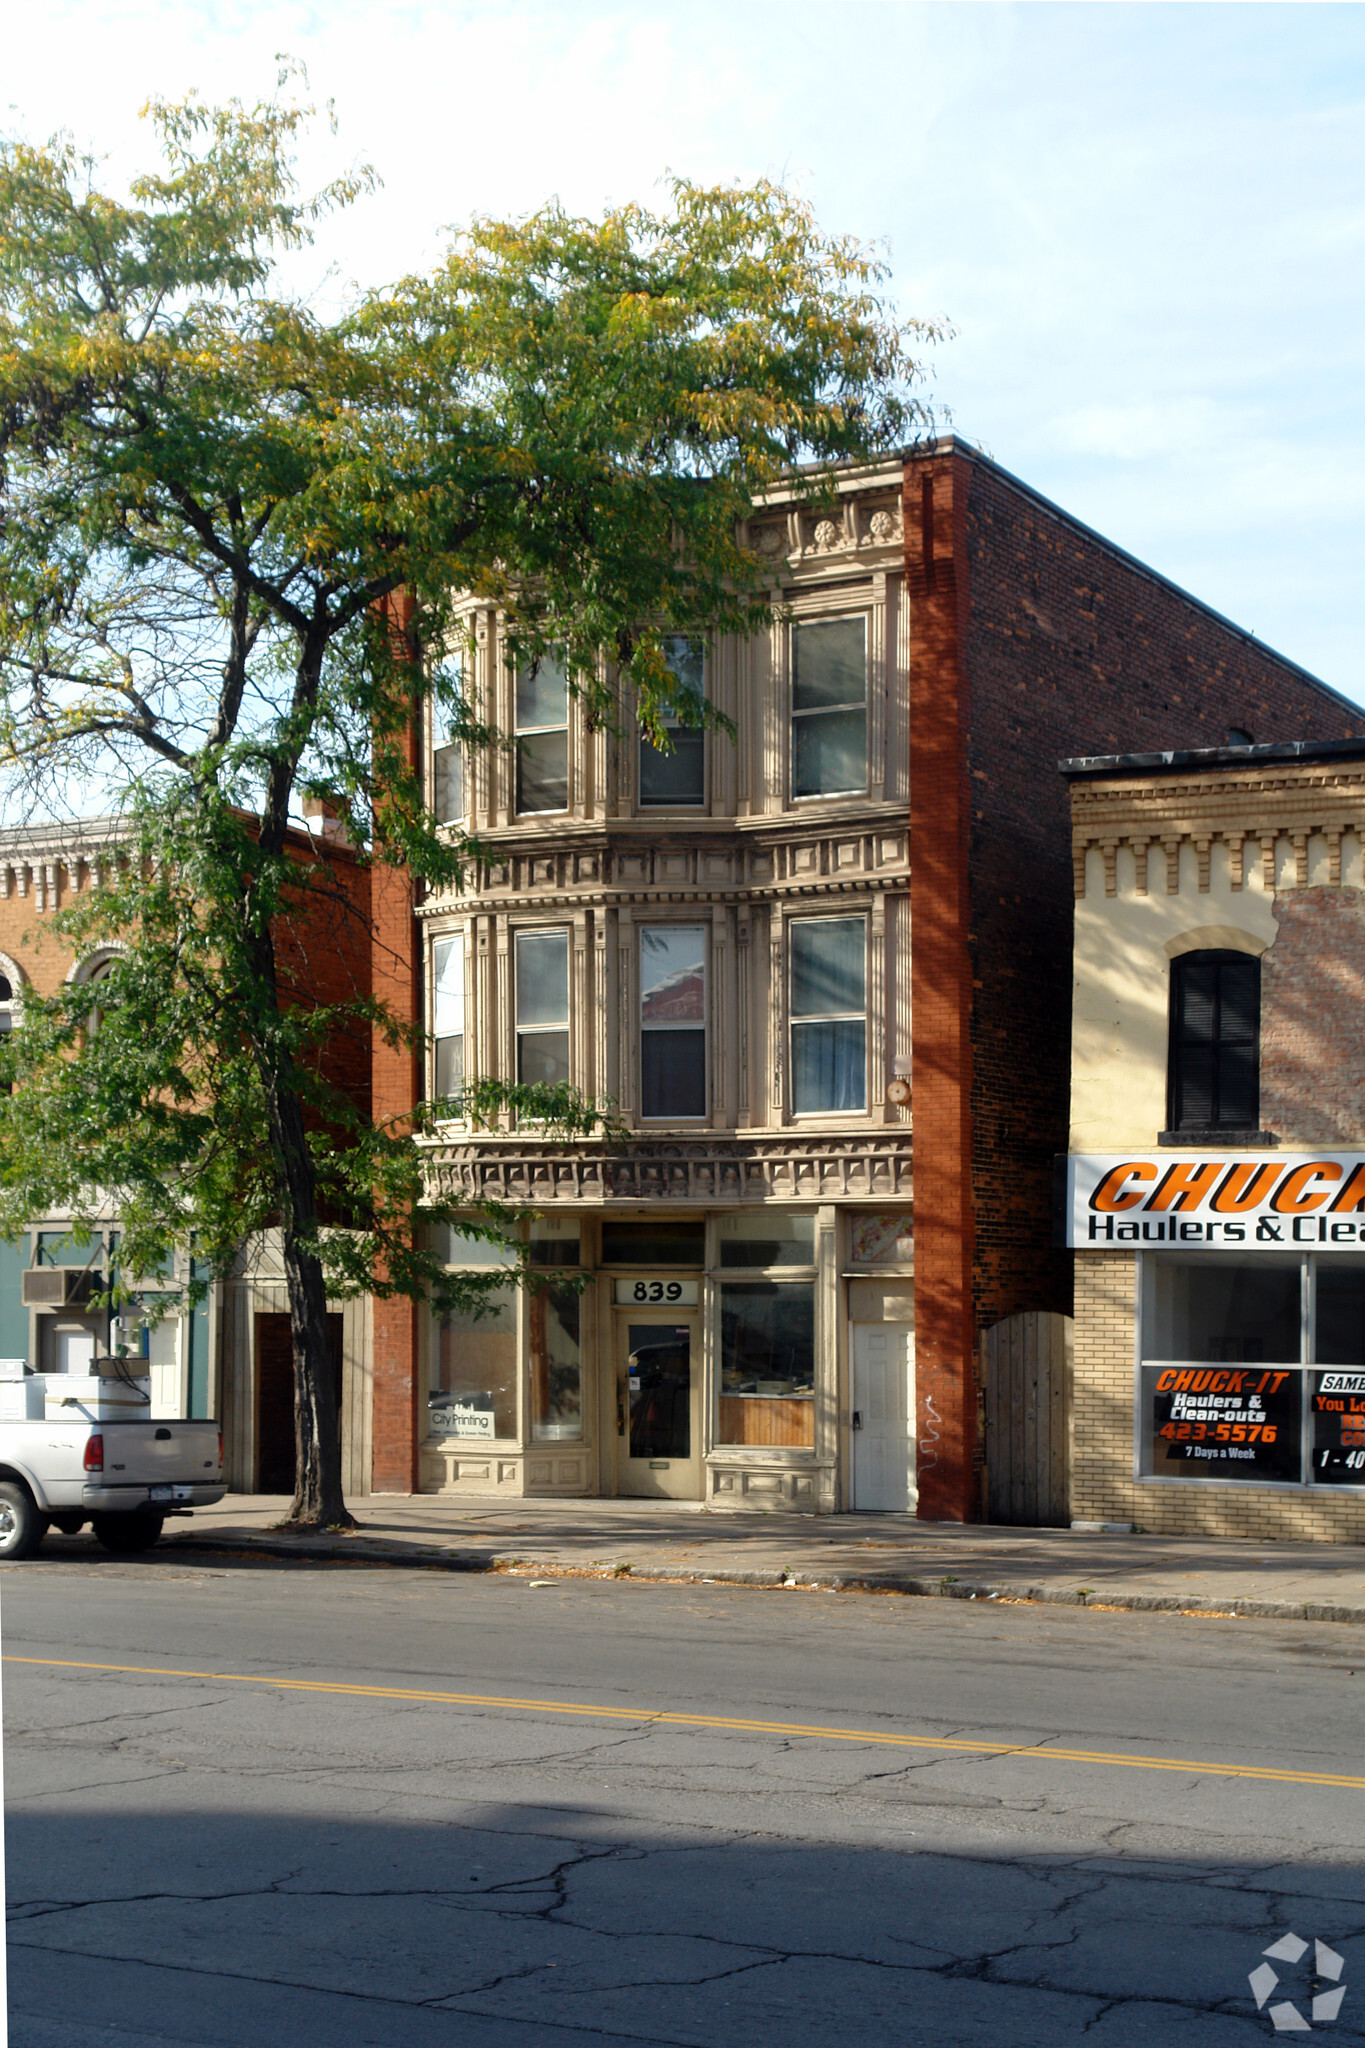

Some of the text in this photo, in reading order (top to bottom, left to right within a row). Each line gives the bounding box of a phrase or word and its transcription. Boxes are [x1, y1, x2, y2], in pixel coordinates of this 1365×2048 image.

[1088, 1215, 1365, 1242] Haulers & Cle
[633, 1281, 682, 1302] 839
[1156, 1369, 1290, 1394] CHUCK-IT
[1173, 1393, 1262, 1409] Haulers &
[1316, 1396, 1345, 1412] You
[432, 1413, 488, 1428] City Printing
[1170, 1406, 1266, 1422] Clean-outs
[1159, 1422, 1277, 1443] 423-5576
[1340, 1431, 1365, 1446] CO
[1185, 1446, 1256, 1460] 7 Days a Week
[1320, 1449, 1330, 1468] 1
[1345, 1450, 1365, 1469] 40
